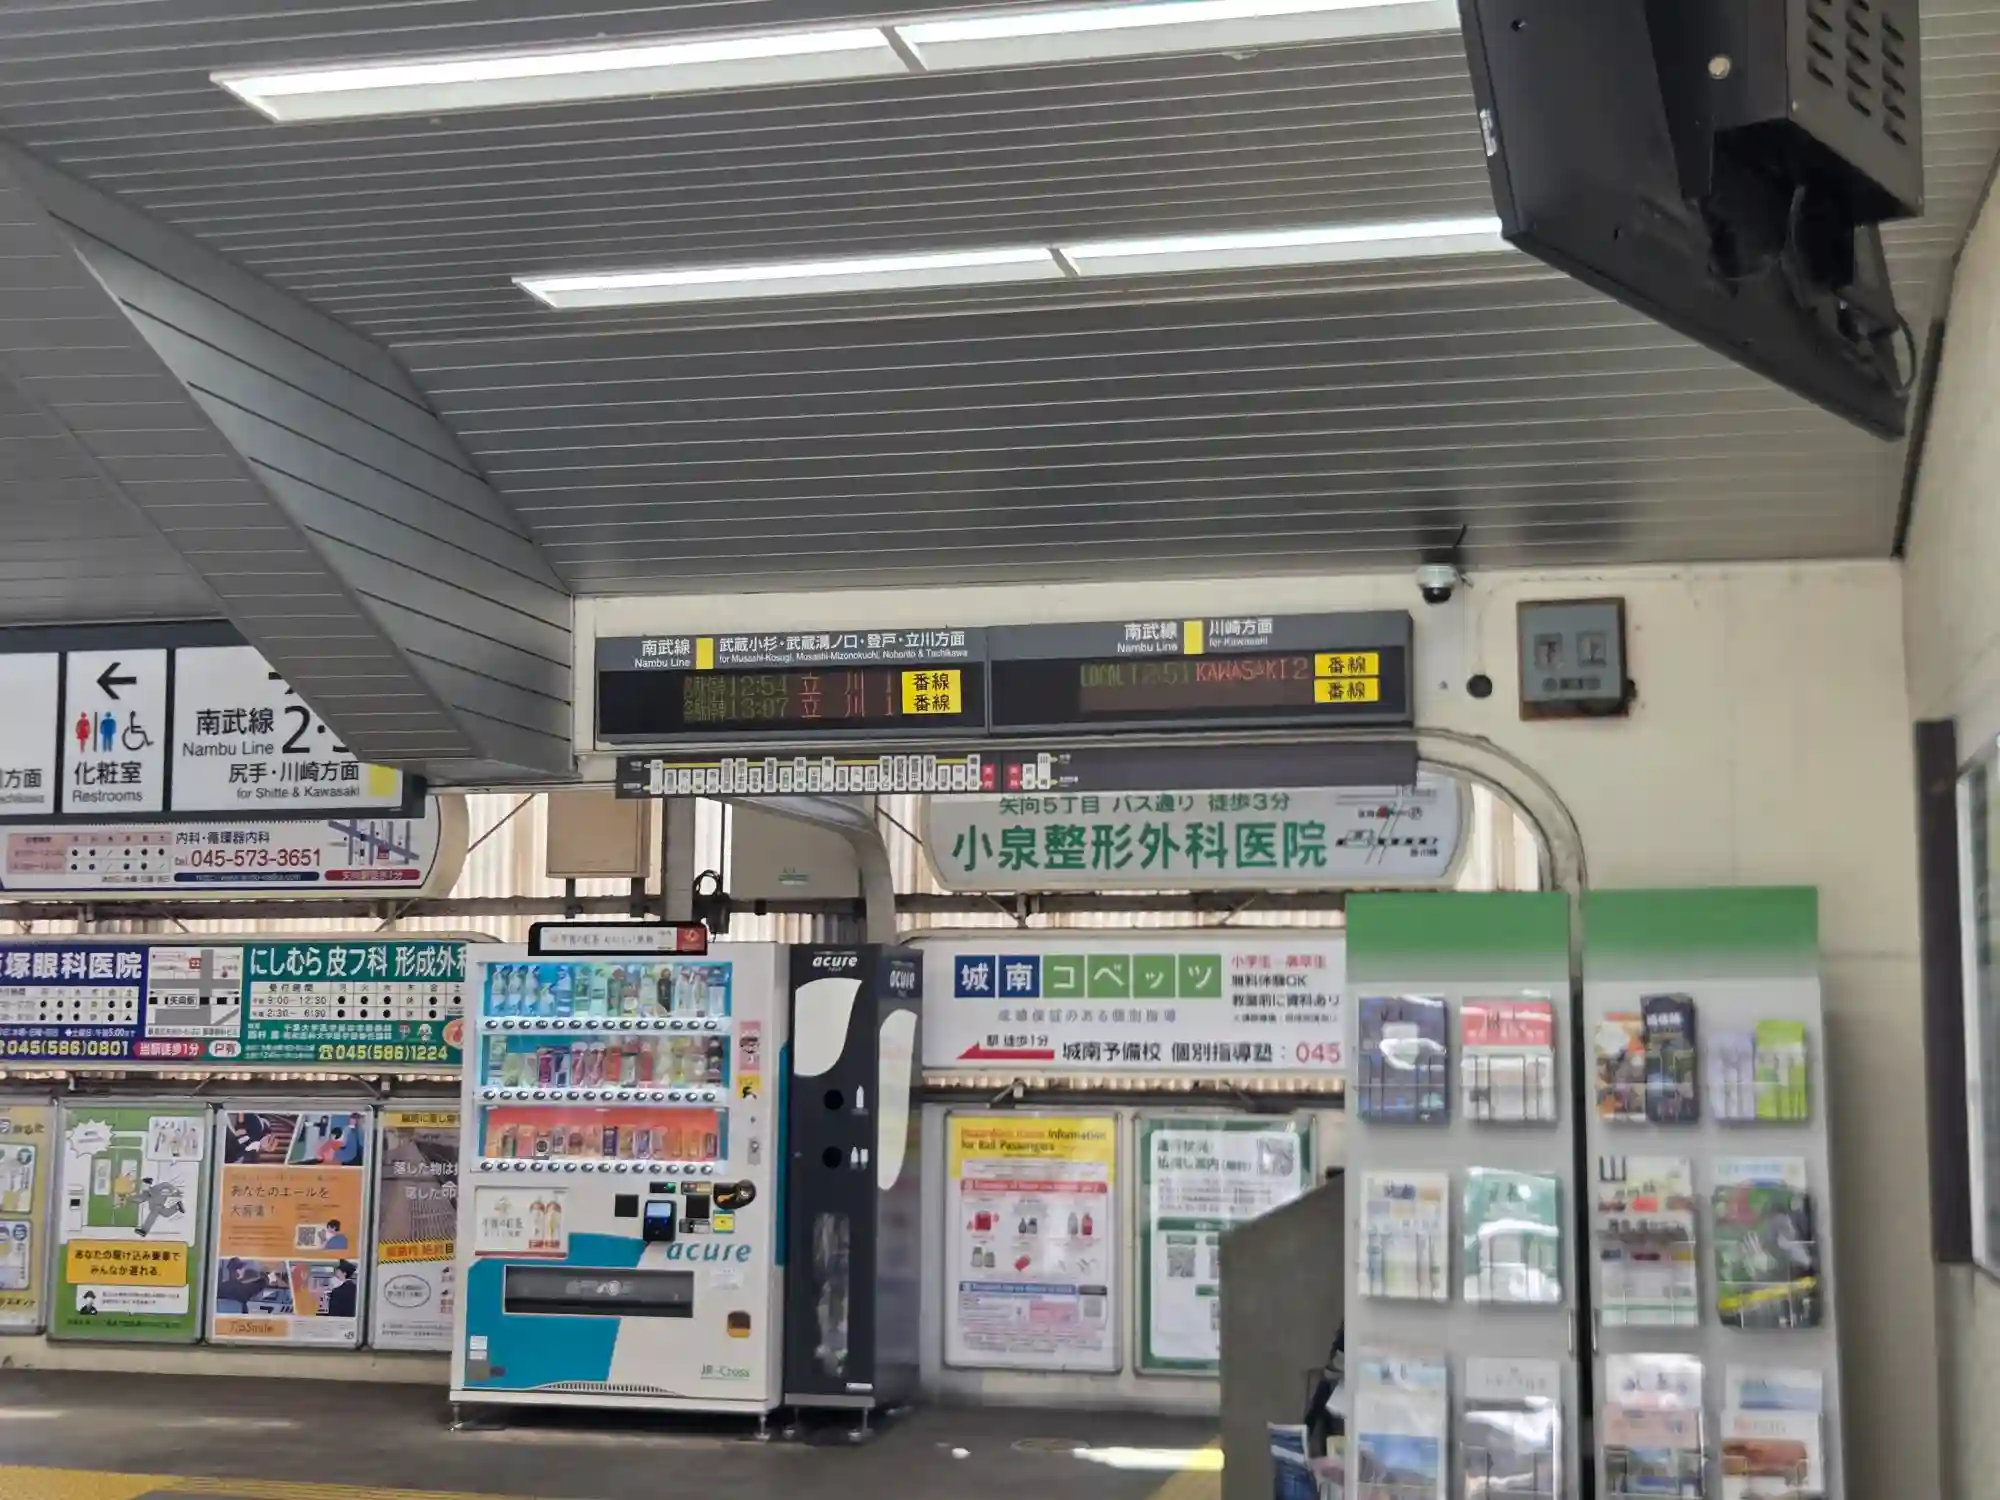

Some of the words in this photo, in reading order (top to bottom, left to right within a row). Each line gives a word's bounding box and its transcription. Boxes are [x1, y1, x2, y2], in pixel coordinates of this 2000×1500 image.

[1124, 622, 1177, 641] 南武線
[1209, 619, 1273, 636] 川崎方面
[642, 639, 690, 656] 南武線
[1117, 643, 1153, 653] Nambu
[1156, 642, 1178, 652] Line
[634, 658, 668, 669] Nambu
[670, 657, 690, 668] Line
[1292, 657, 1309, 680] 2
[1328, 655, 1366, 674] 番線
[913, 673, 949, 691] 番線
[1328, 681, 1366, 699] 番線
[913, 694, 950, 712] 番線
[196, 708, 275, 736] 南武線
[182, 742, 237, 757] Nambu
[242, 741, 274, 756] Line
[0, 768, 43, 789] 方面
[74, 761, 142, 786] 化粧室
[229, 761, 360, 784] 尻手・川崎方面
[72, 789, 143, 803] Restrooms
[237, 788, 251, 799] for
[256, 787, 289, 798] Shitte
[293, 787, 300, 798] &
[304, 786, 360, 797] Kawasaki
[1000, 796, 1099, 815] 矢向5丁目
[1112, 793, 1194, 813] バス通り
[1209, 792, 1290, 812] 徒歩3分
[175, 831, 270, 845] 内科・循環器内科
[952, 820, 1328, 872] 小泉整形外科医院
[191, 849, 322, 868] 045-573-3651
[250, 948, 322, 975] にしむら
[326, 946, 388, 977] 皮フ科
[812, 955, 858, 967] acure
[890, 970, 915, 989] acure
[961, 962, 1212, 992] 城南コベッツ
[9, 1040, 128, 1056] 045(586)0801
[1004, 1034, 1049, 1046] 徒歩1分
[336, 1044, 448, 1060] 045(586)1224
[1062, 1042, 1161, 1062] 城南予備校
[1296, 1041, 1341, 1064] 045
[1048, 1127, 1106, 1141] Information
[231, 1184, 330, 1200] あなたのエールを
[666, 1241, 752, 1263] acure
